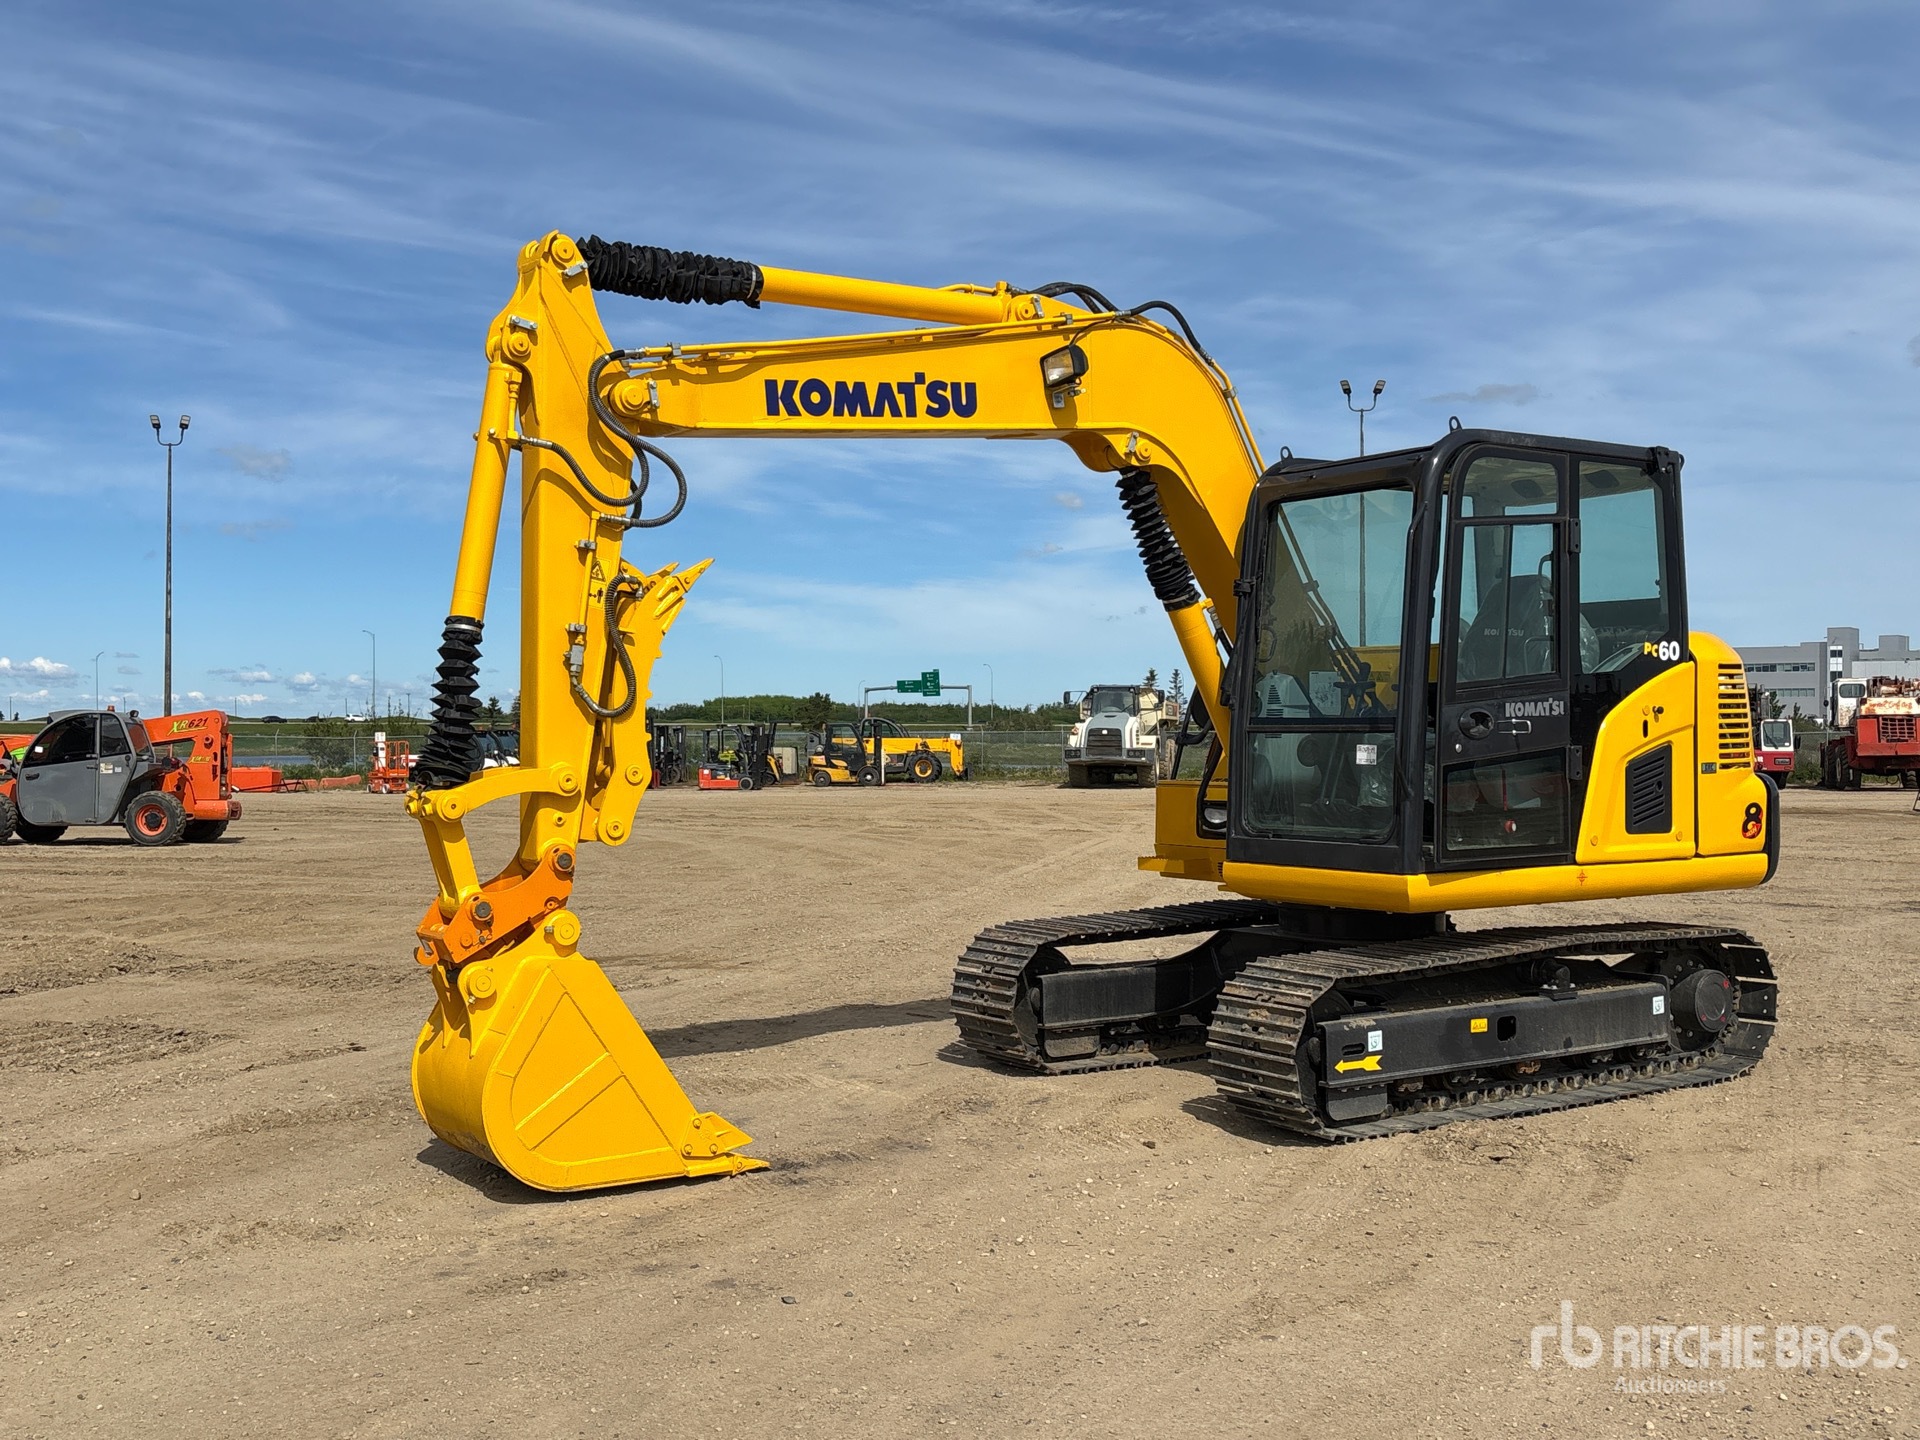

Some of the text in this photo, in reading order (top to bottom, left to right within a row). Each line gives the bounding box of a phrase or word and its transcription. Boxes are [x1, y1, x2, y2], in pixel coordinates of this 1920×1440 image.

[764, 372, 978, 418] KOMATSU
[1484, 628, 1525, 637] KOTSU
[1643, 640, 1680, 661] PC60
[168, 717, 209, 736] XR621
